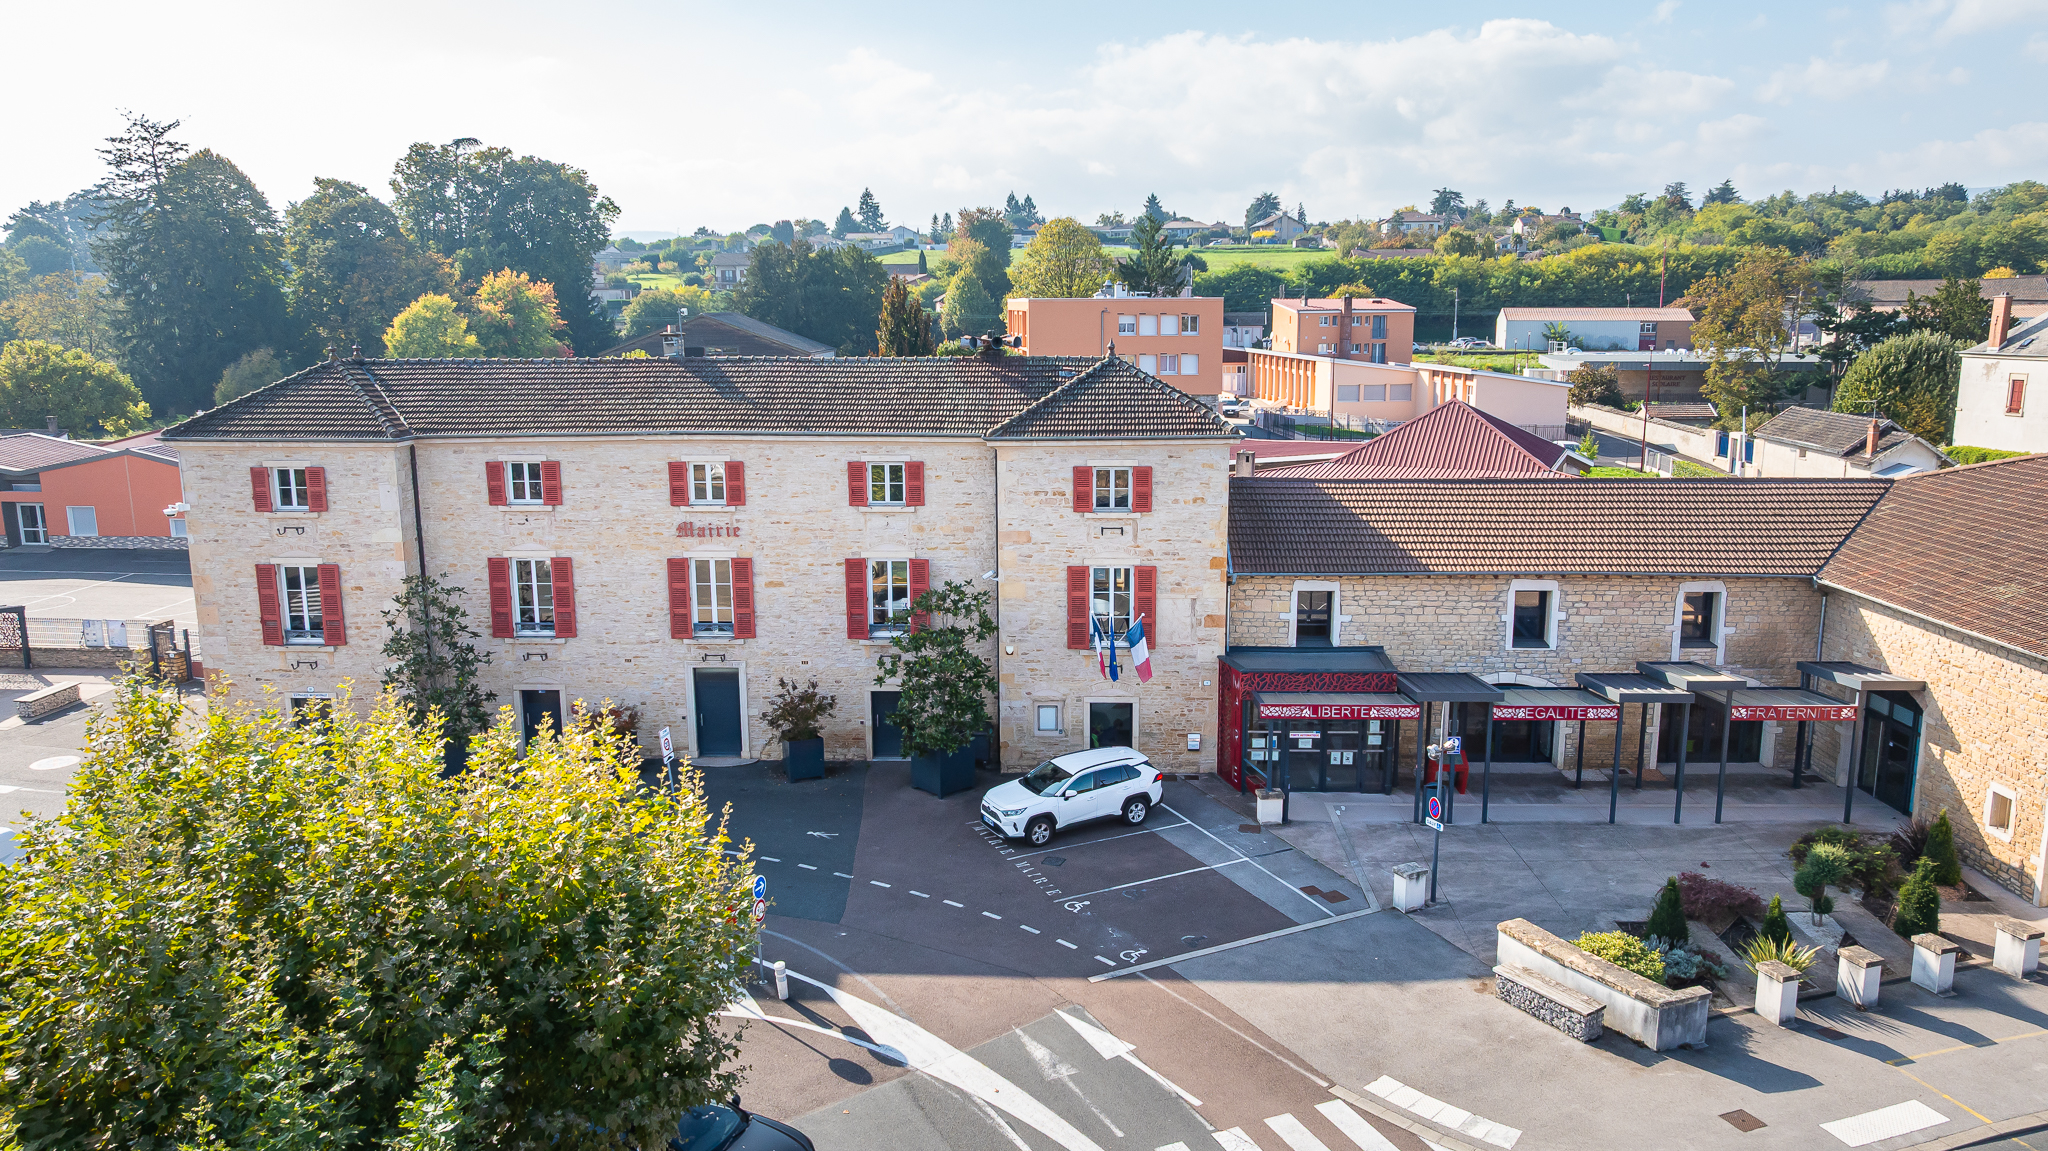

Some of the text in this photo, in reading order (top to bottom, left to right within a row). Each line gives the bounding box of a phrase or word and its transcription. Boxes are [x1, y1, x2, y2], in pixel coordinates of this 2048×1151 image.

[676, 521, 740, 538] Mairie
[1310, 706, 1370, 718] LIBERTE
[1525, 707, 1587, 719] EGALITE
[1747, 707, 1839, 719] FRATERNITE
[1014, 861, 1062, 896] MAIRIE
